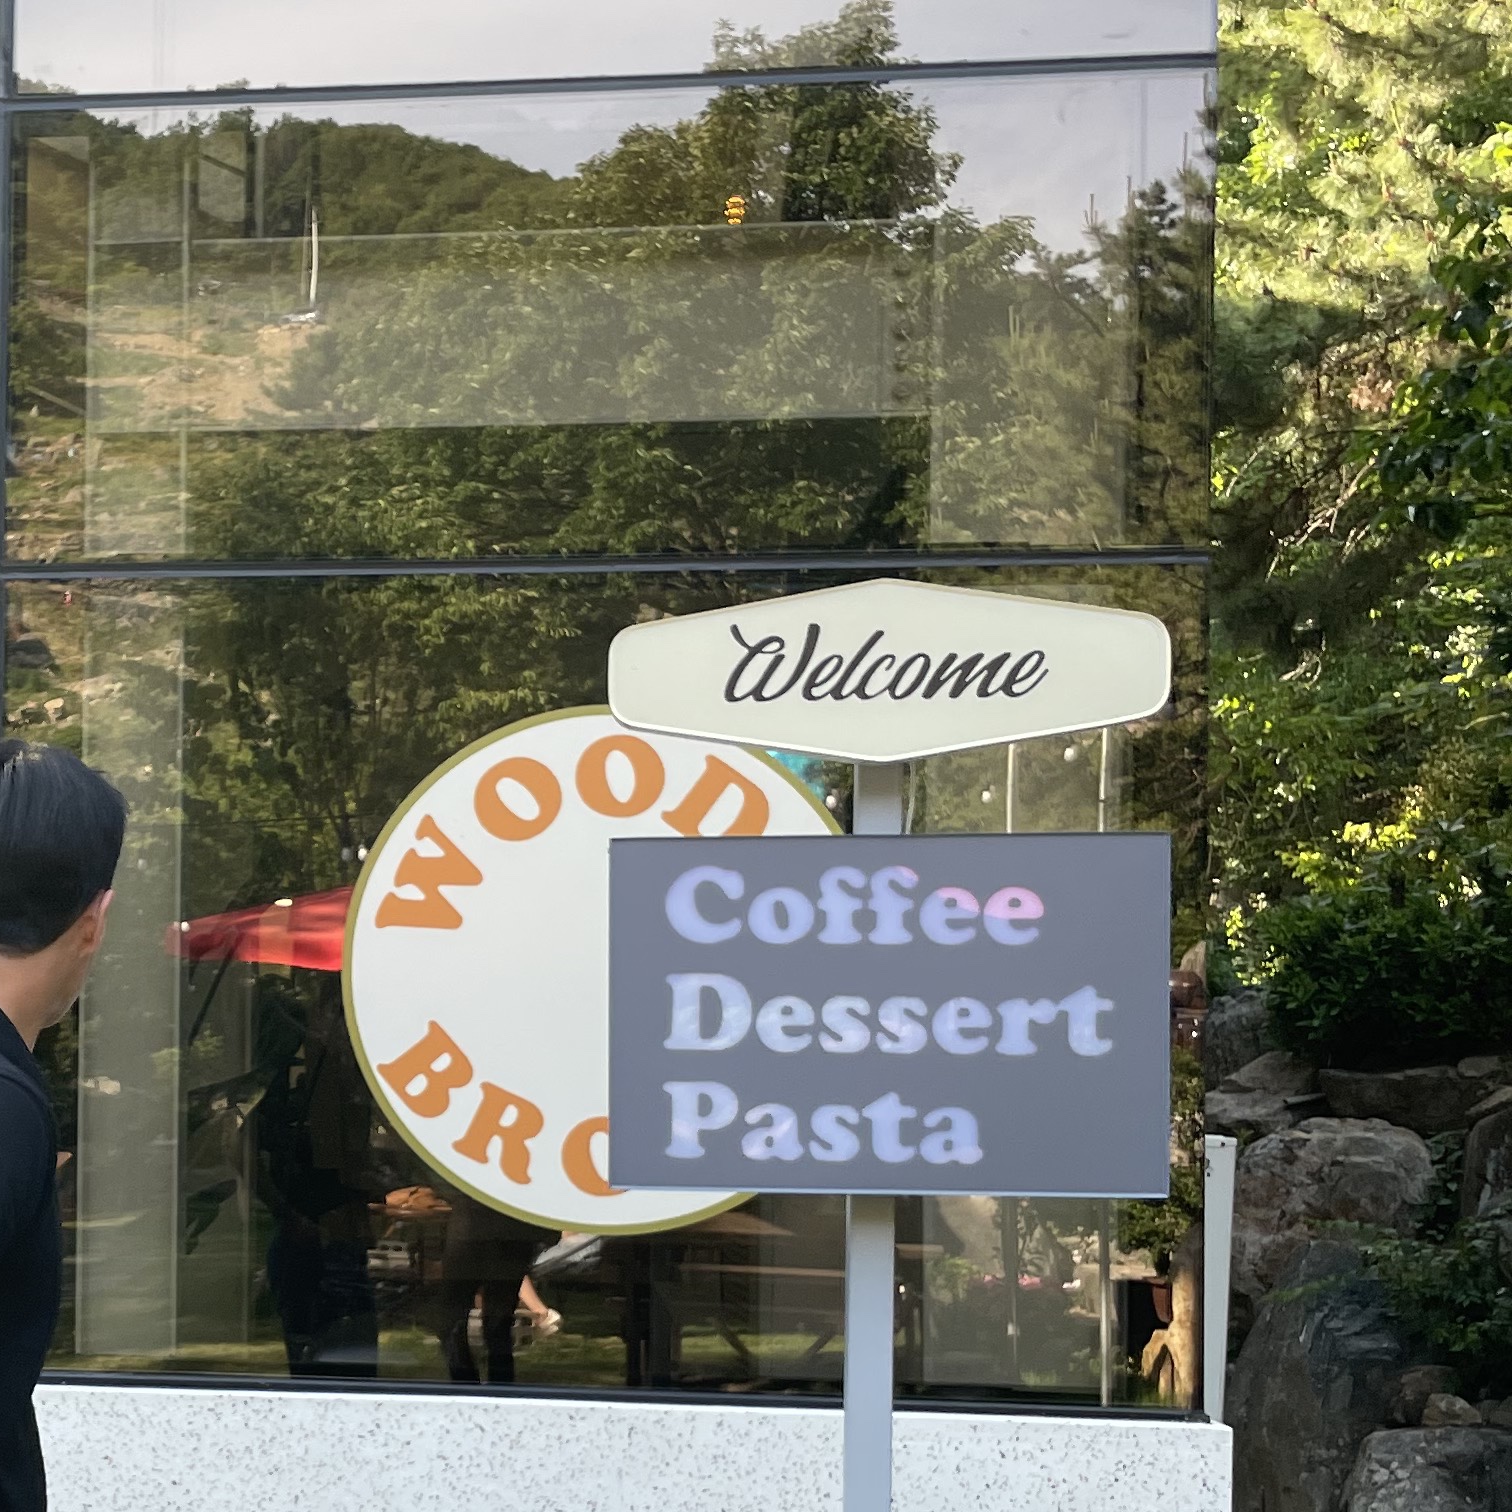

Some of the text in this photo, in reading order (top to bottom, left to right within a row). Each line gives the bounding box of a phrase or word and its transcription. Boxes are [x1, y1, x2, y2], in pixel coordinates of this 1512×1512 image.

[724, 623, 1049, 702] Welcome
[375, 734, 769, 929] WOOD
[665, 865, 1045, 945] Coffee
[663, 972, 1114, 1056] Dessert
[662, 1081, 983, 1165] Pasta
